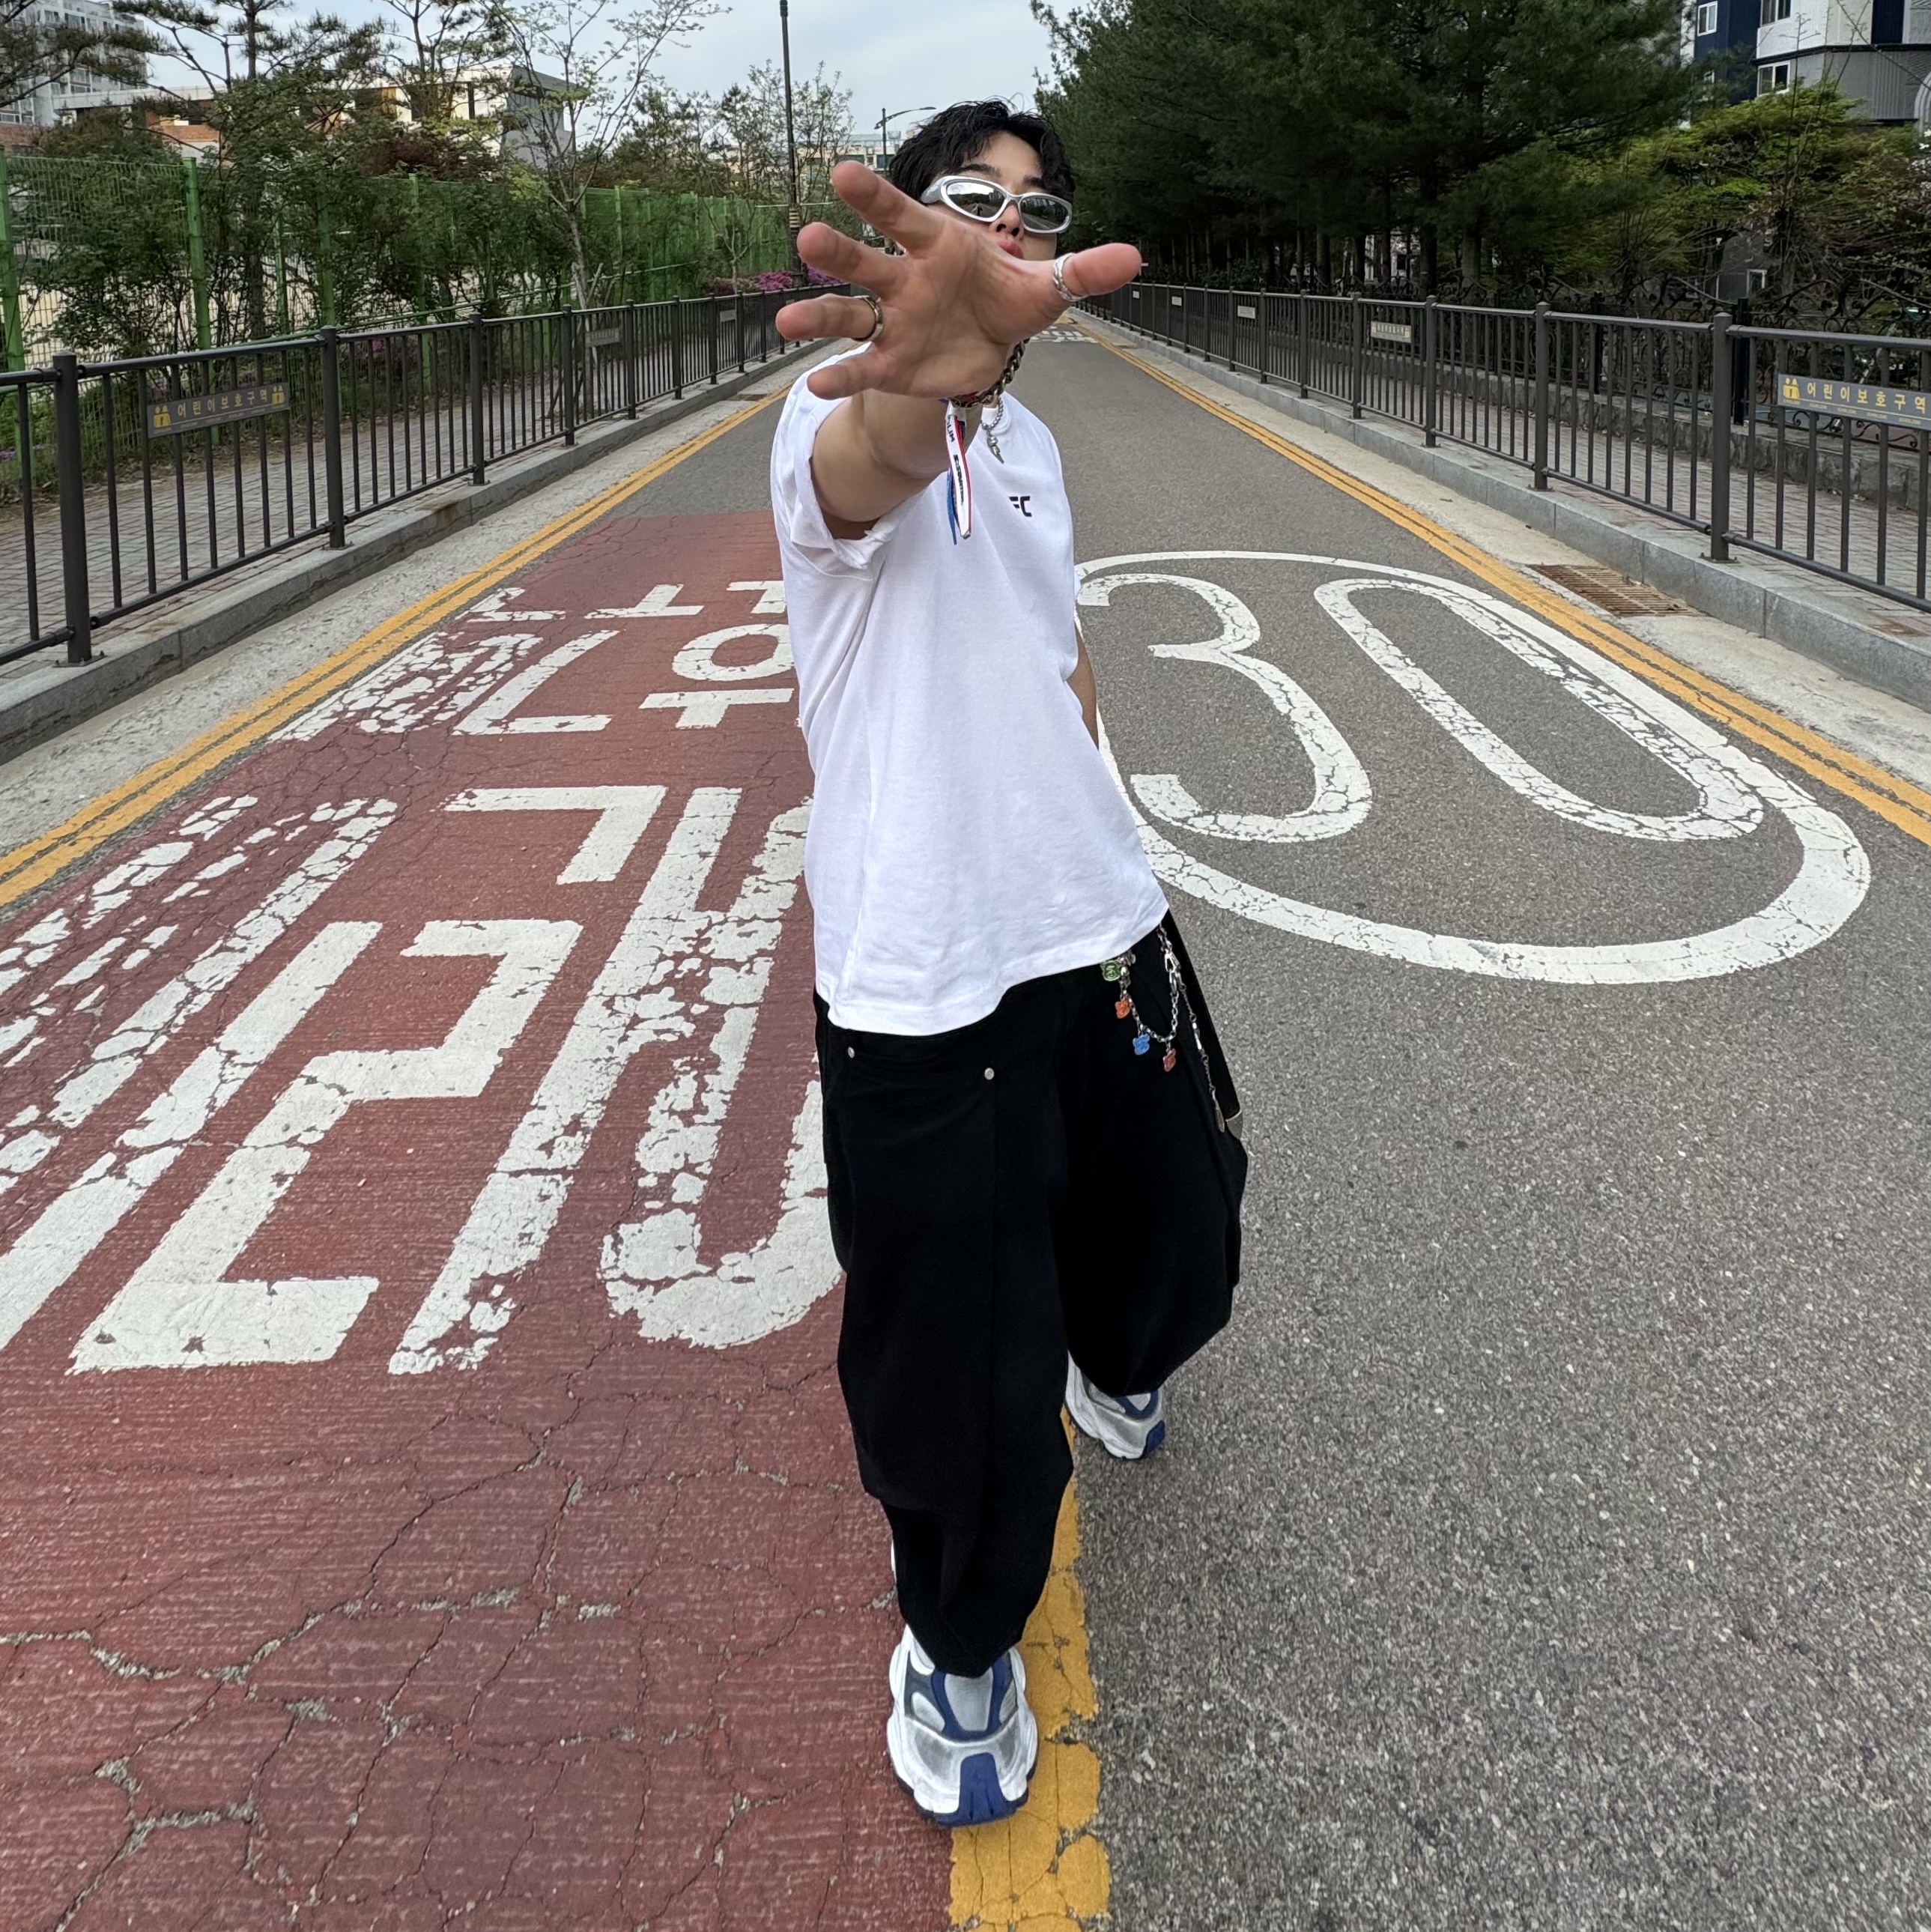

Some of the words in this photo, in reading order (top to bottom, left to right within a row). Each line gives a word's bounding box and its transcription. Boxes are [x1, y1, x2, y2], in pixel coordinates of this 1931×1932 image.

[177, 388, 267, 417] 어린이보호구역
[1807, 381, 1927, 414] 어린이보호구역
[266, 580, 798, 745] 호구역
[1078, 572, 1764, 843] 30
